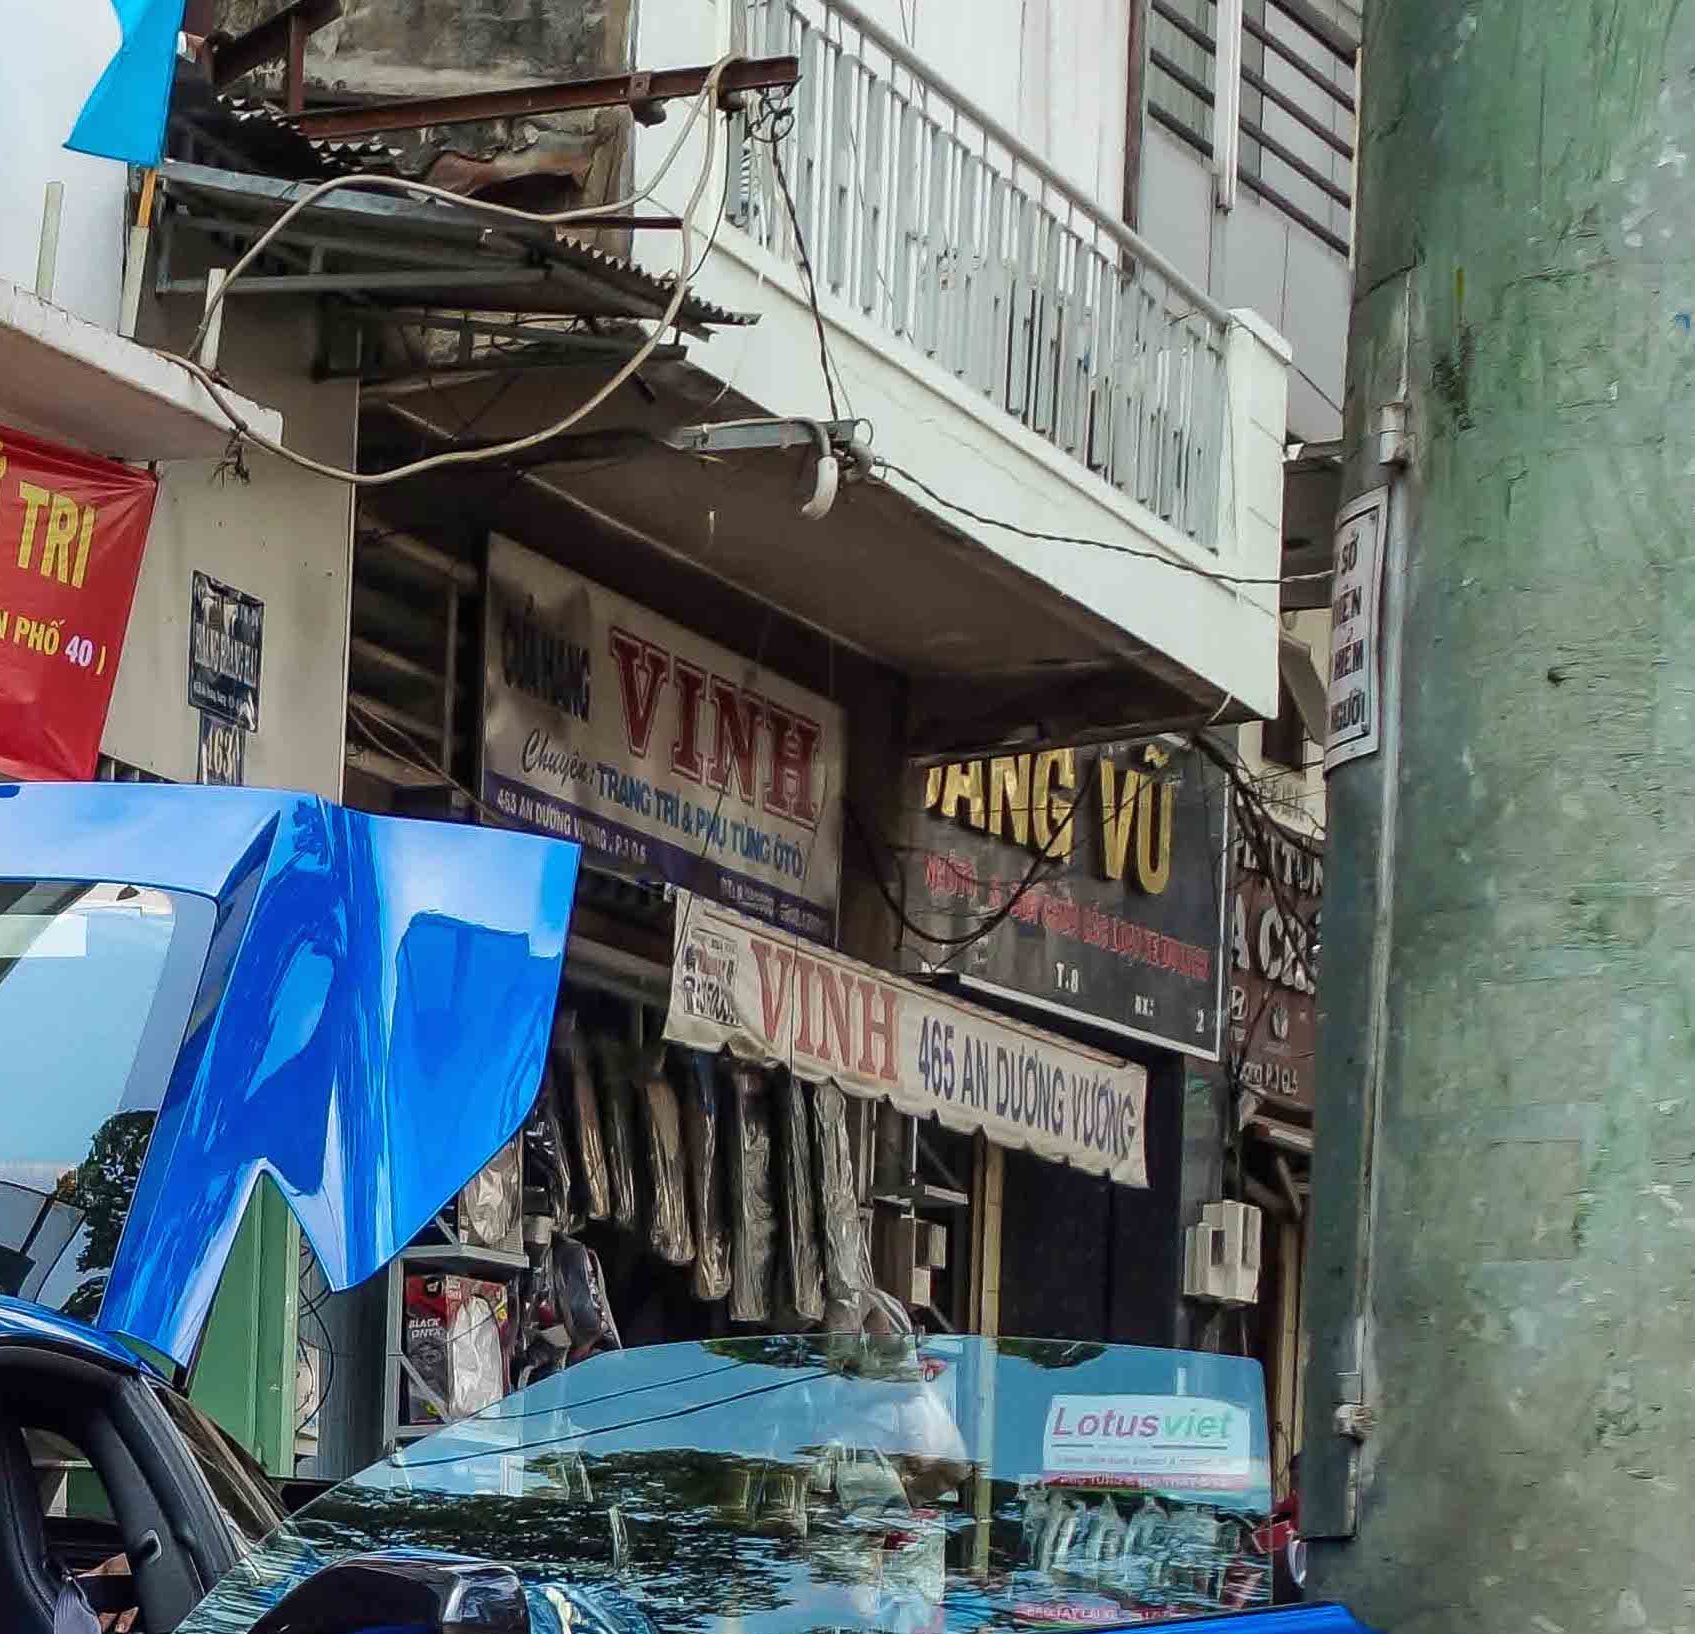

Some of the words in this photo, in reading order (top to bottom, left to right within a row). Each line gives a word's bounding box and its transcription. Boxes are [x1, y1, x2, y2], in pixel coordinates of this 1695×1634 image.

[15, 481, 99, 589] TRI
[12, 616, 67, 657] PHỐ
[65, 635, 93, 667] 40
[596, 761, 652, 817] TRANG
[611, 625, 824, 832] VINH
[1099, 743, 1174, 895] VŨ
[747, 938, 901, 1082] VINH
[917, 1015, 956, 1098] 465
[962, 1034, 990, 1113] AN
[995, 1040, 1066, 1138] DƯƠNG
[1071, 1066, 1137, 1160] VƯƠNG
